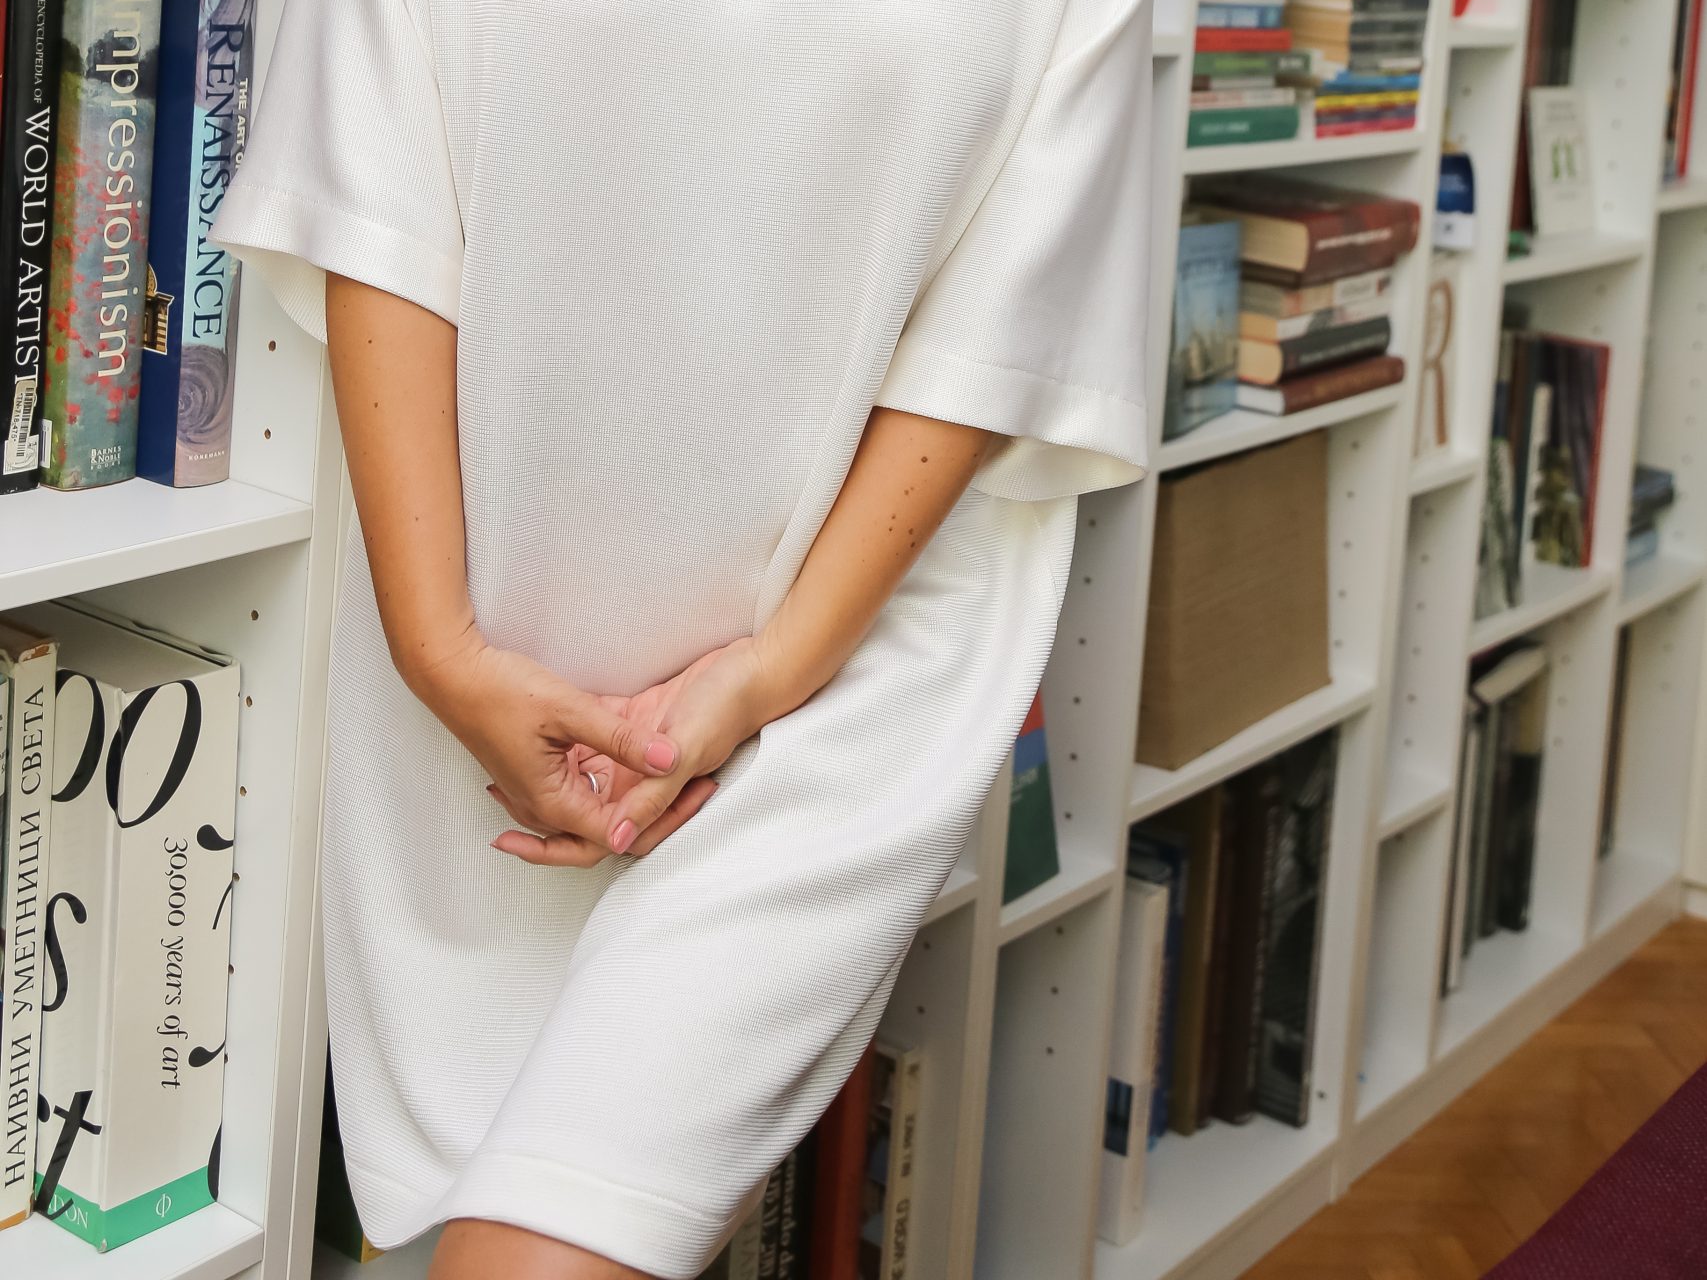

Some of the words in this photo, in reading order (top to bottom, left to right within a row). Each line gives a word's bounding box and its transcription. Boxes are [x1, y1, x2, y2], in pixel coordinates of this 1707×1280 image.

[33, 88, 43, 104] OF
[235, 115, 247, 149] ART
[237, 77, 249, 111] THE
[20, 106, 50, 248] WORLD
[14, 258, 43, 407] ARTIST
[20, 684, 45, 796] СВЕТА
[12, 808, 43, 1020] УМЕТНИЦИ
[163, 836, 188, 927] 30,000
[160, 935, 185, 1006] years
[156, 1014, 189, 1040] of
[160, 1046, 181, 1090] art
[5, 1033, 33, 1189] НАИВНИ
